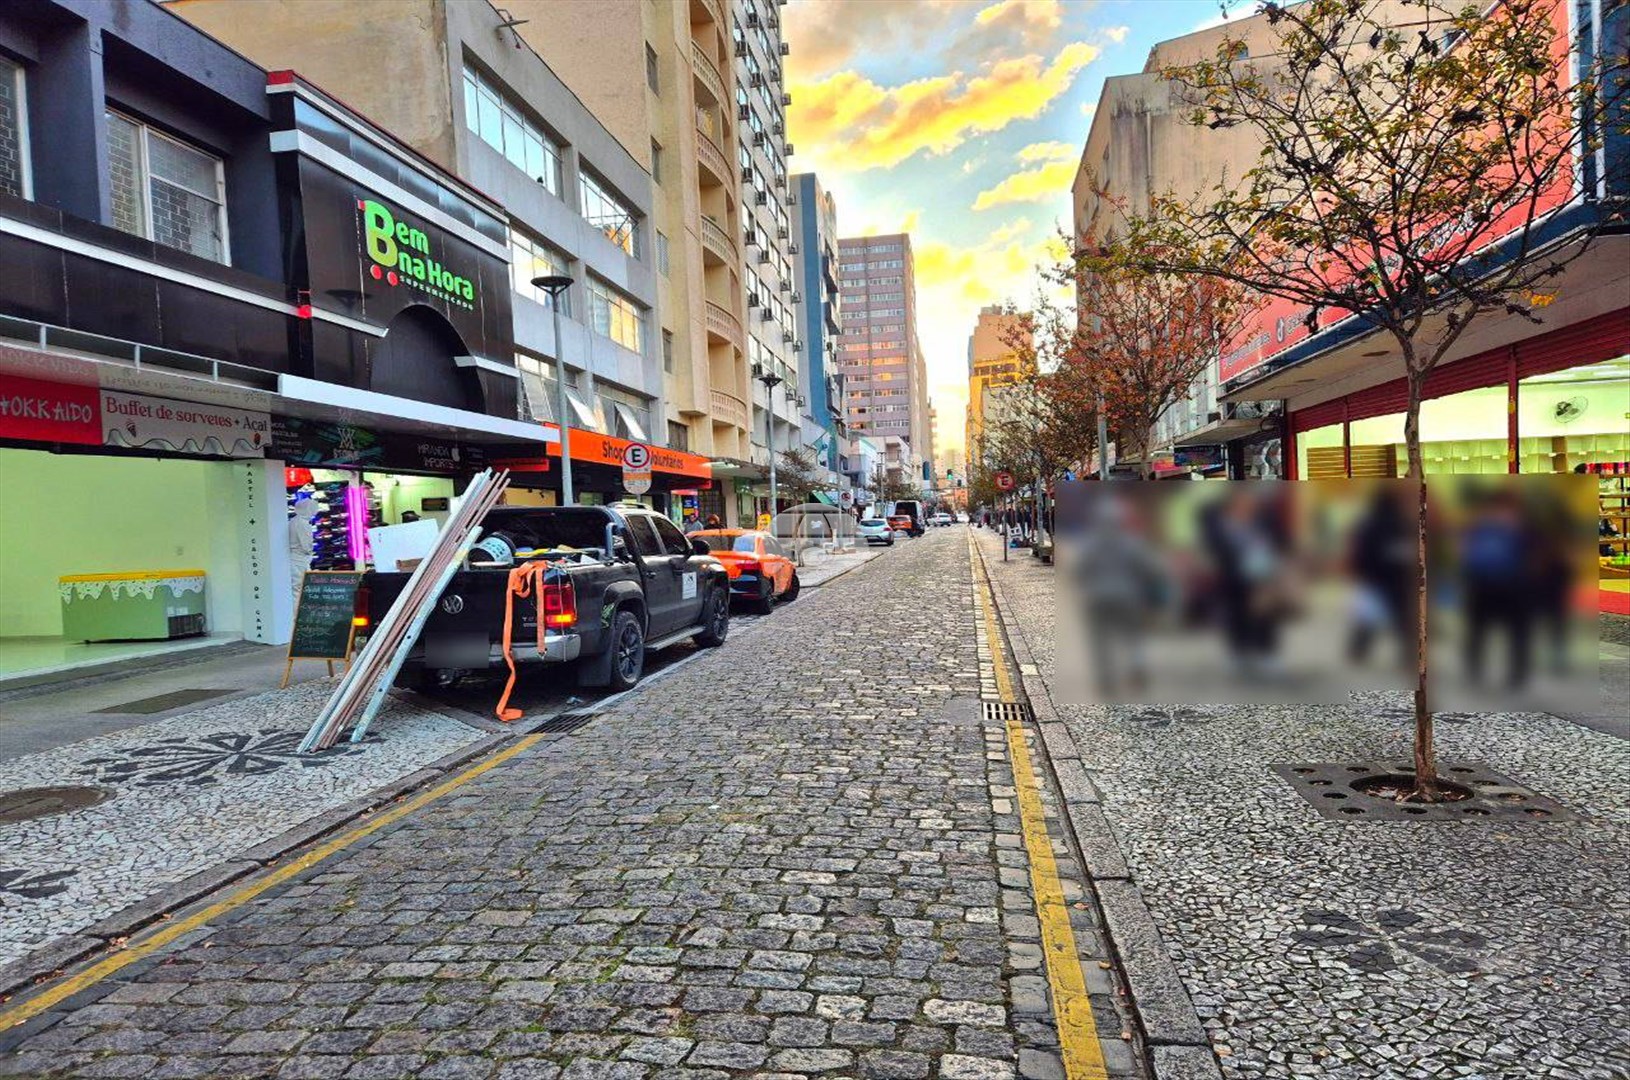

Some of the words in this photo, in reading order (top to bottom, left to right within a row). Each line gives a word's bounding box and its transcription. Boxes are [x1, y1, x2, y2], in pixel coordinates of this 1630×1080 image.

[364, 200, 429, 267] Bem
[106, 396, 152, 418] Buffet
[156, 405, 174, 420] de
[176, 410, 233, 428] sorvetes
[631, 448, 642, 463] E
